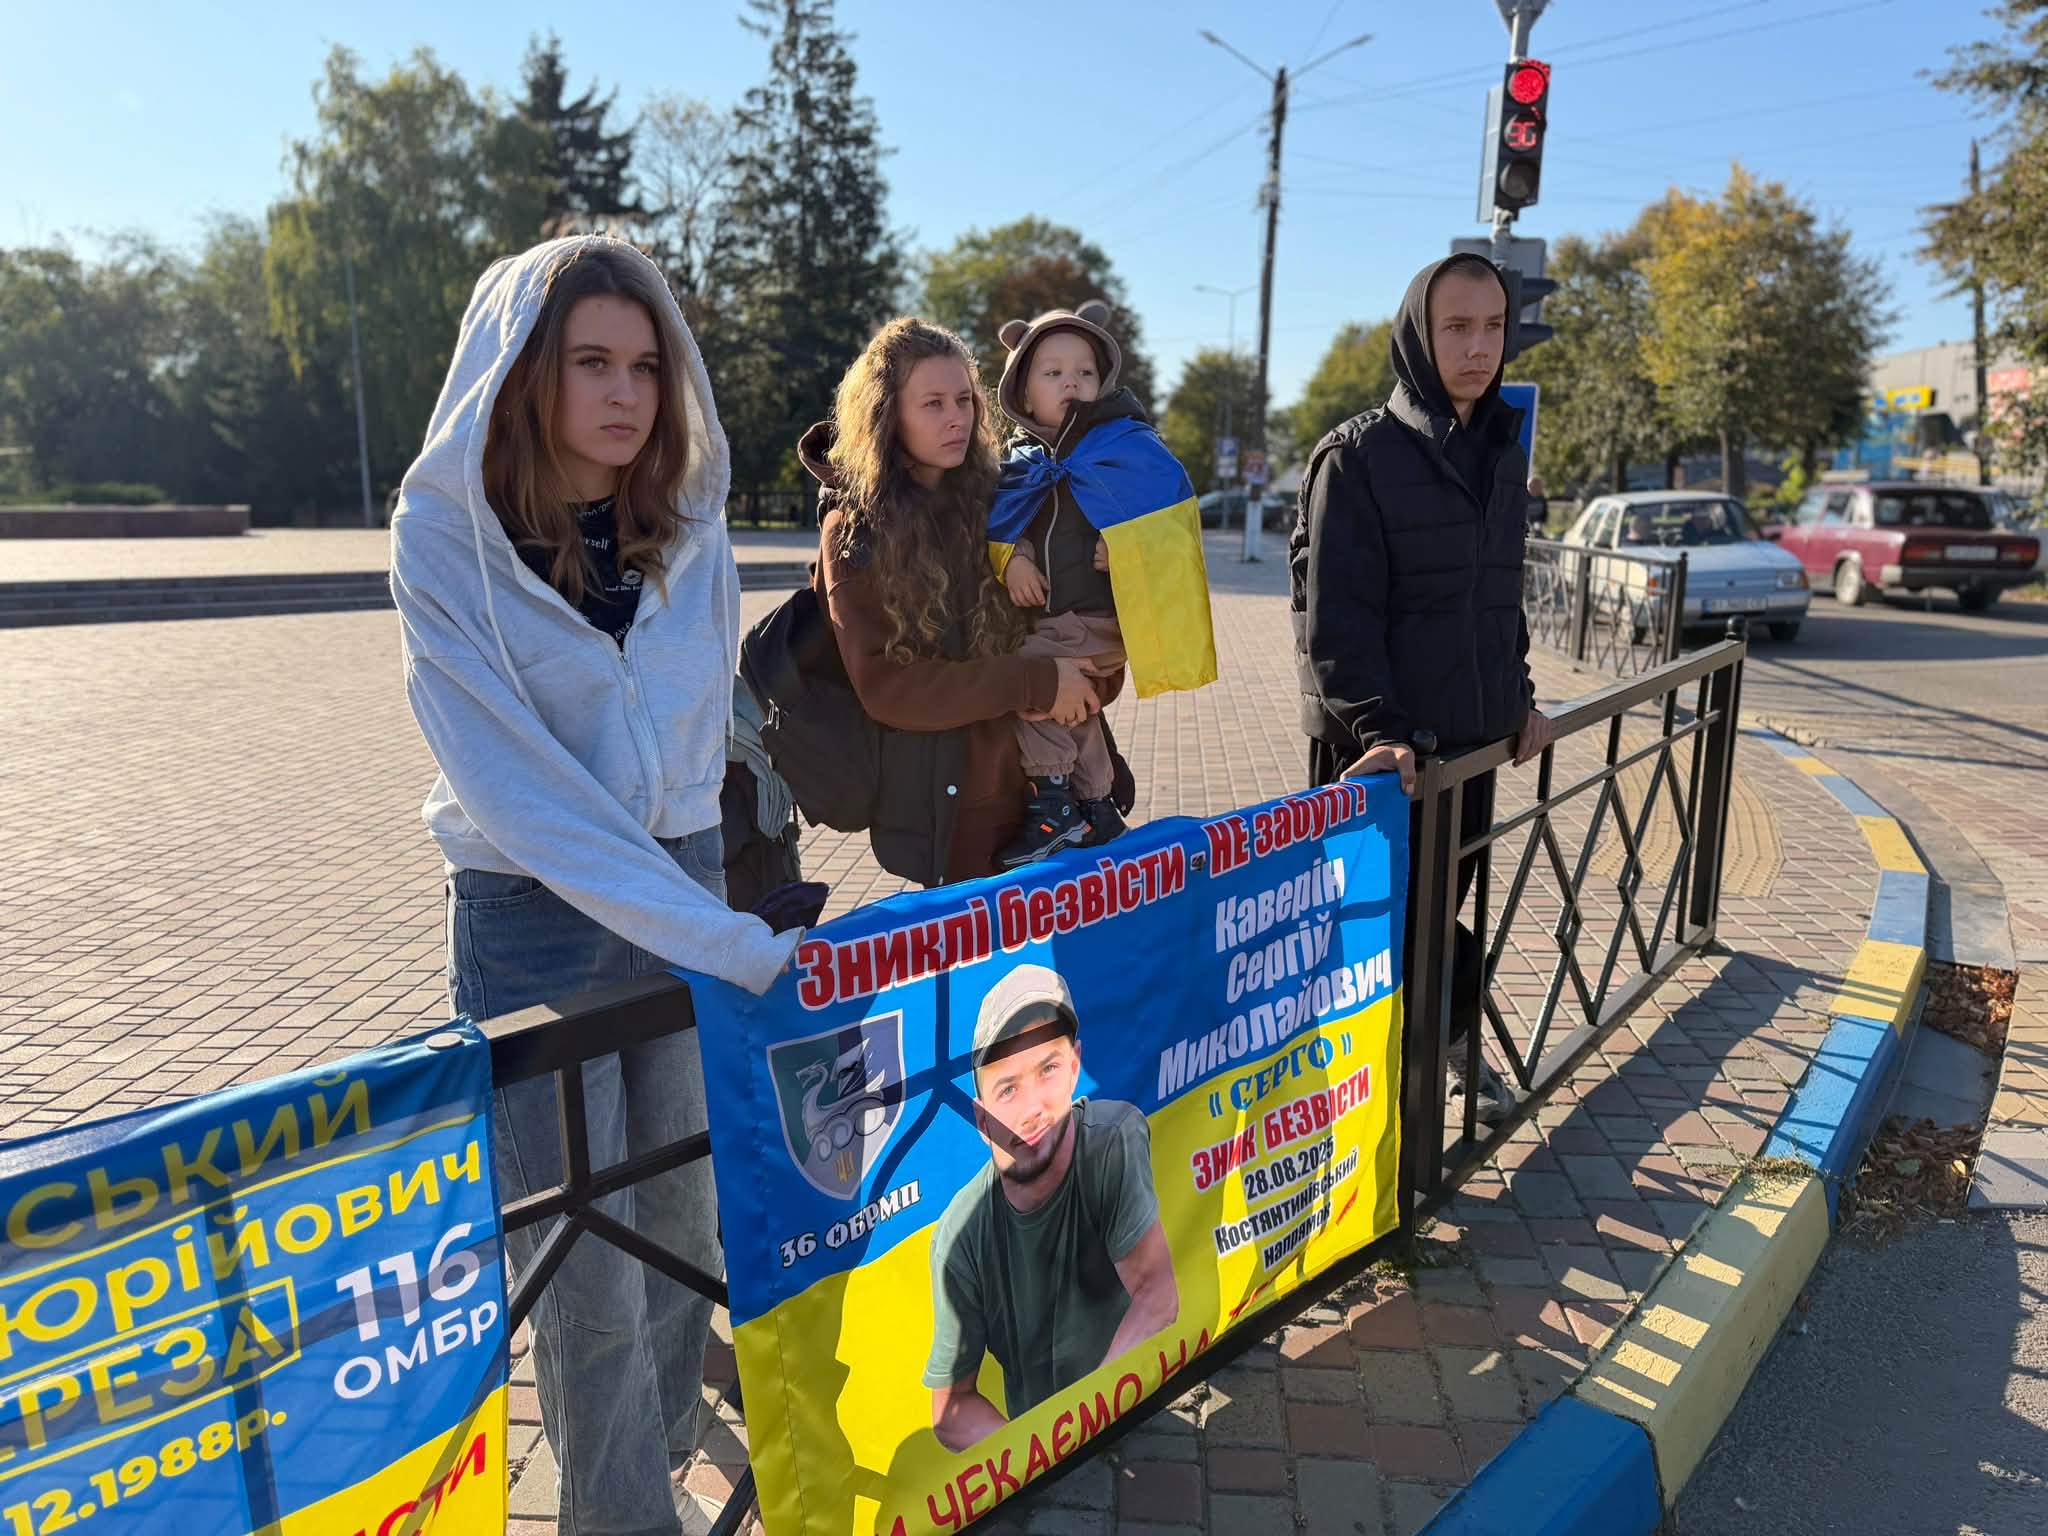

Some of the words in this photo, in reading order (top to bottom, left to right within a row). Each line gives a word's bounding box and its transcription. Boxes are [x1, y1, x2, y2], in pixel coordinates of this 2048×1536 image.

[796, 897, 991, 1010] Зниклі
[998, 843, 1186, 954] безвісти
[1203, 815, 1250, 878] НЕ
[1215, 857, 1345, 953] Каверін
[1226, 910, 1334, 1005] Сергій
[1157, 948, 1392, 1101] Миколайович
[1230, 1036, 1334, 1112] СЕРГО
[1191, 1123, 1257, 1191] ЗНИК
[1263, 1064, 1371, 1151] БЕЗВІСТИ
[1243, 1136, 1335, 1202] 28.08.2025
[780, 1232, 817, 1268] 36
[1214, 1148, 1359, 1254] Костянтинівський
[1264, 1203, 1332, 1270] напрямок
[335, 1222, 481, 1343] 116
[0, 1305, 288, 1462] РЕЗА
[333, 1300, 498, 1401] ОМБр
[926, 1372, 1143, 1532] ЧЕКАЄМО
